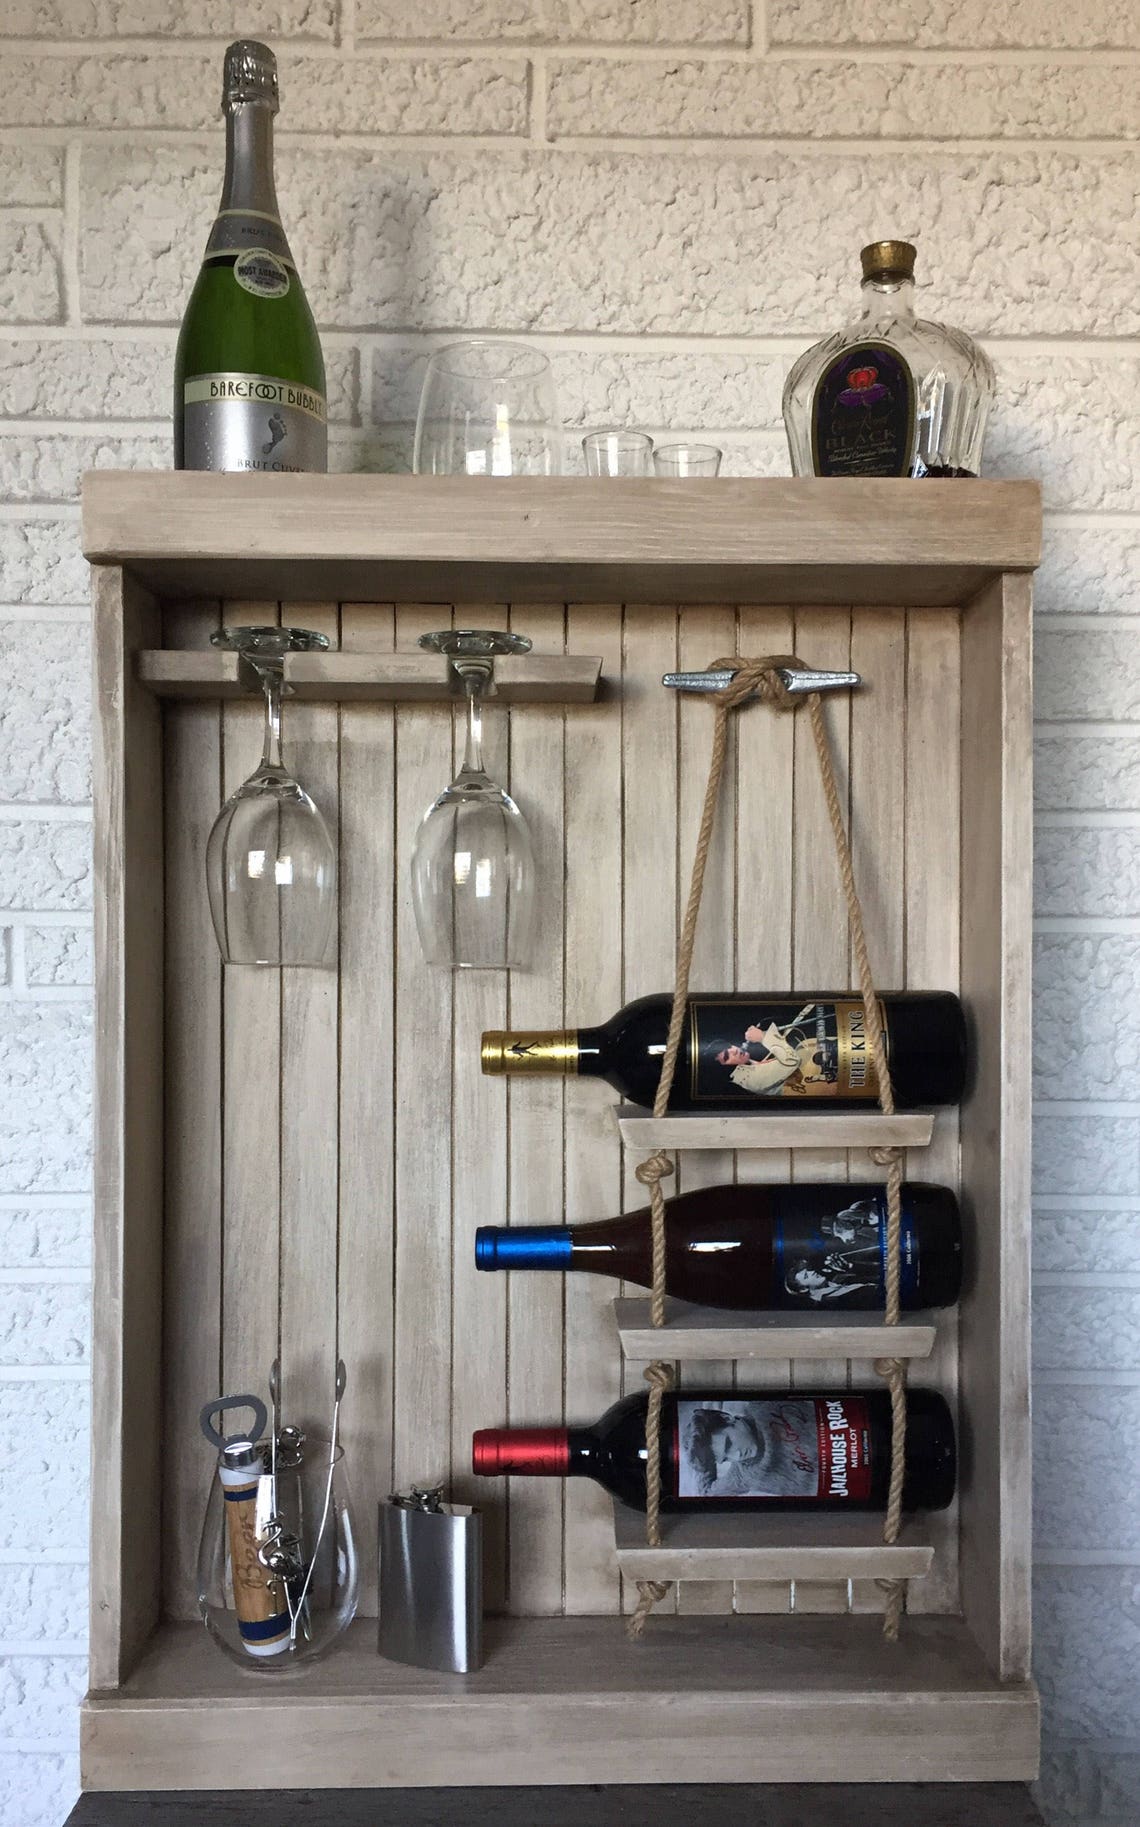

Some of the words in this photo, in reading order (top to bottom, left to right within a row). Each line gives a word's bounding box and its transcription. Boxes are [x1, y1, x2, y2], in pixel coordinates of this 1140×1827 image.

[210, 381, 284, 402] BAREFOOT
[237, 458, 268, 470] BRUT
[847, 1010, 866, 1051] KING
[847, 1056, 866, 1089] THE
[825, 1400, 849, 1431] ROCK
[849, 1427, 858, 1468] MERLOT
[828, 1432, 849, 1497] JAILHOUSE
